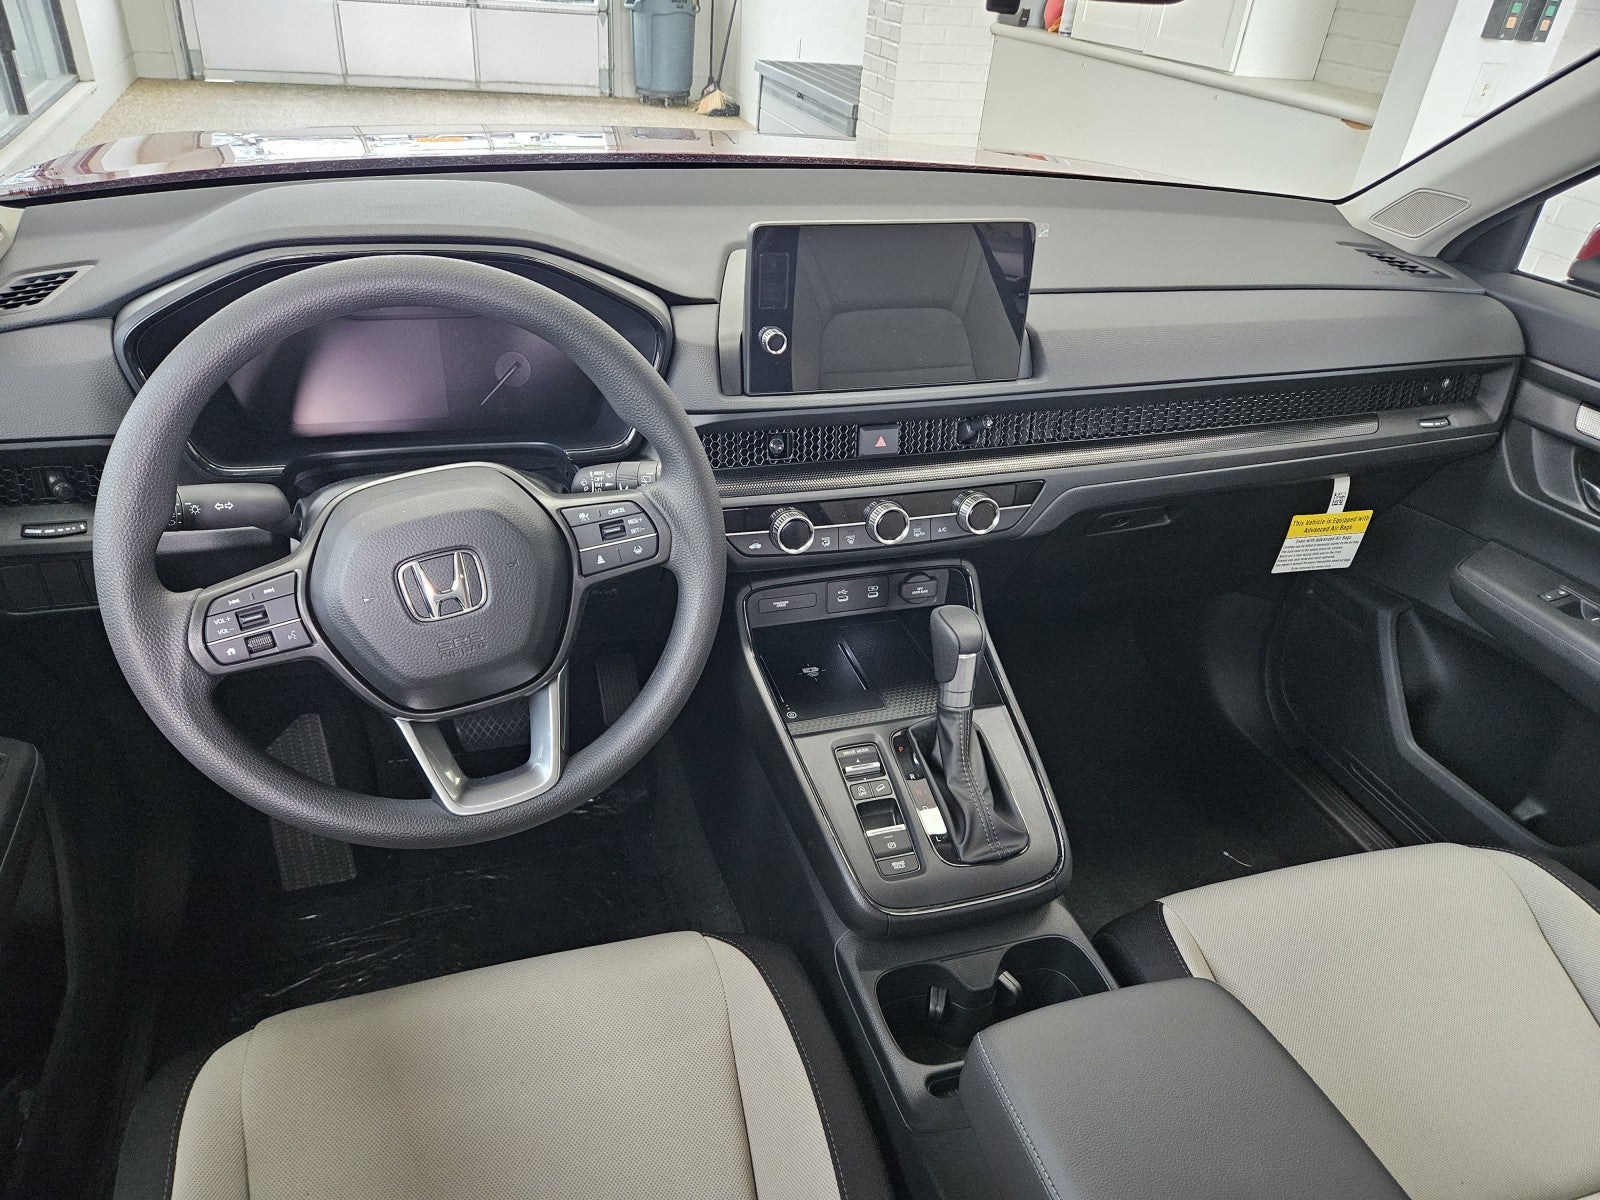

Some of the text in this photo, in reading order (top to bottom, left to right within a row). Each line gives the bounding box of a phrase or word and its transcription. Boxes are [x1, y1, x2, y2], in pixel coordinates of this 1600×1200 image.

[608, 507, 626, 515] CANCEL
[1305, 518, 1325, 526] Vehicle
[1326, 517, 1332, 525] is
[1333, 516, 1358, 525] Equipped
[1303, 525, 1330, 534] Advanced
[1340, 524, 1352, 532] Bags
